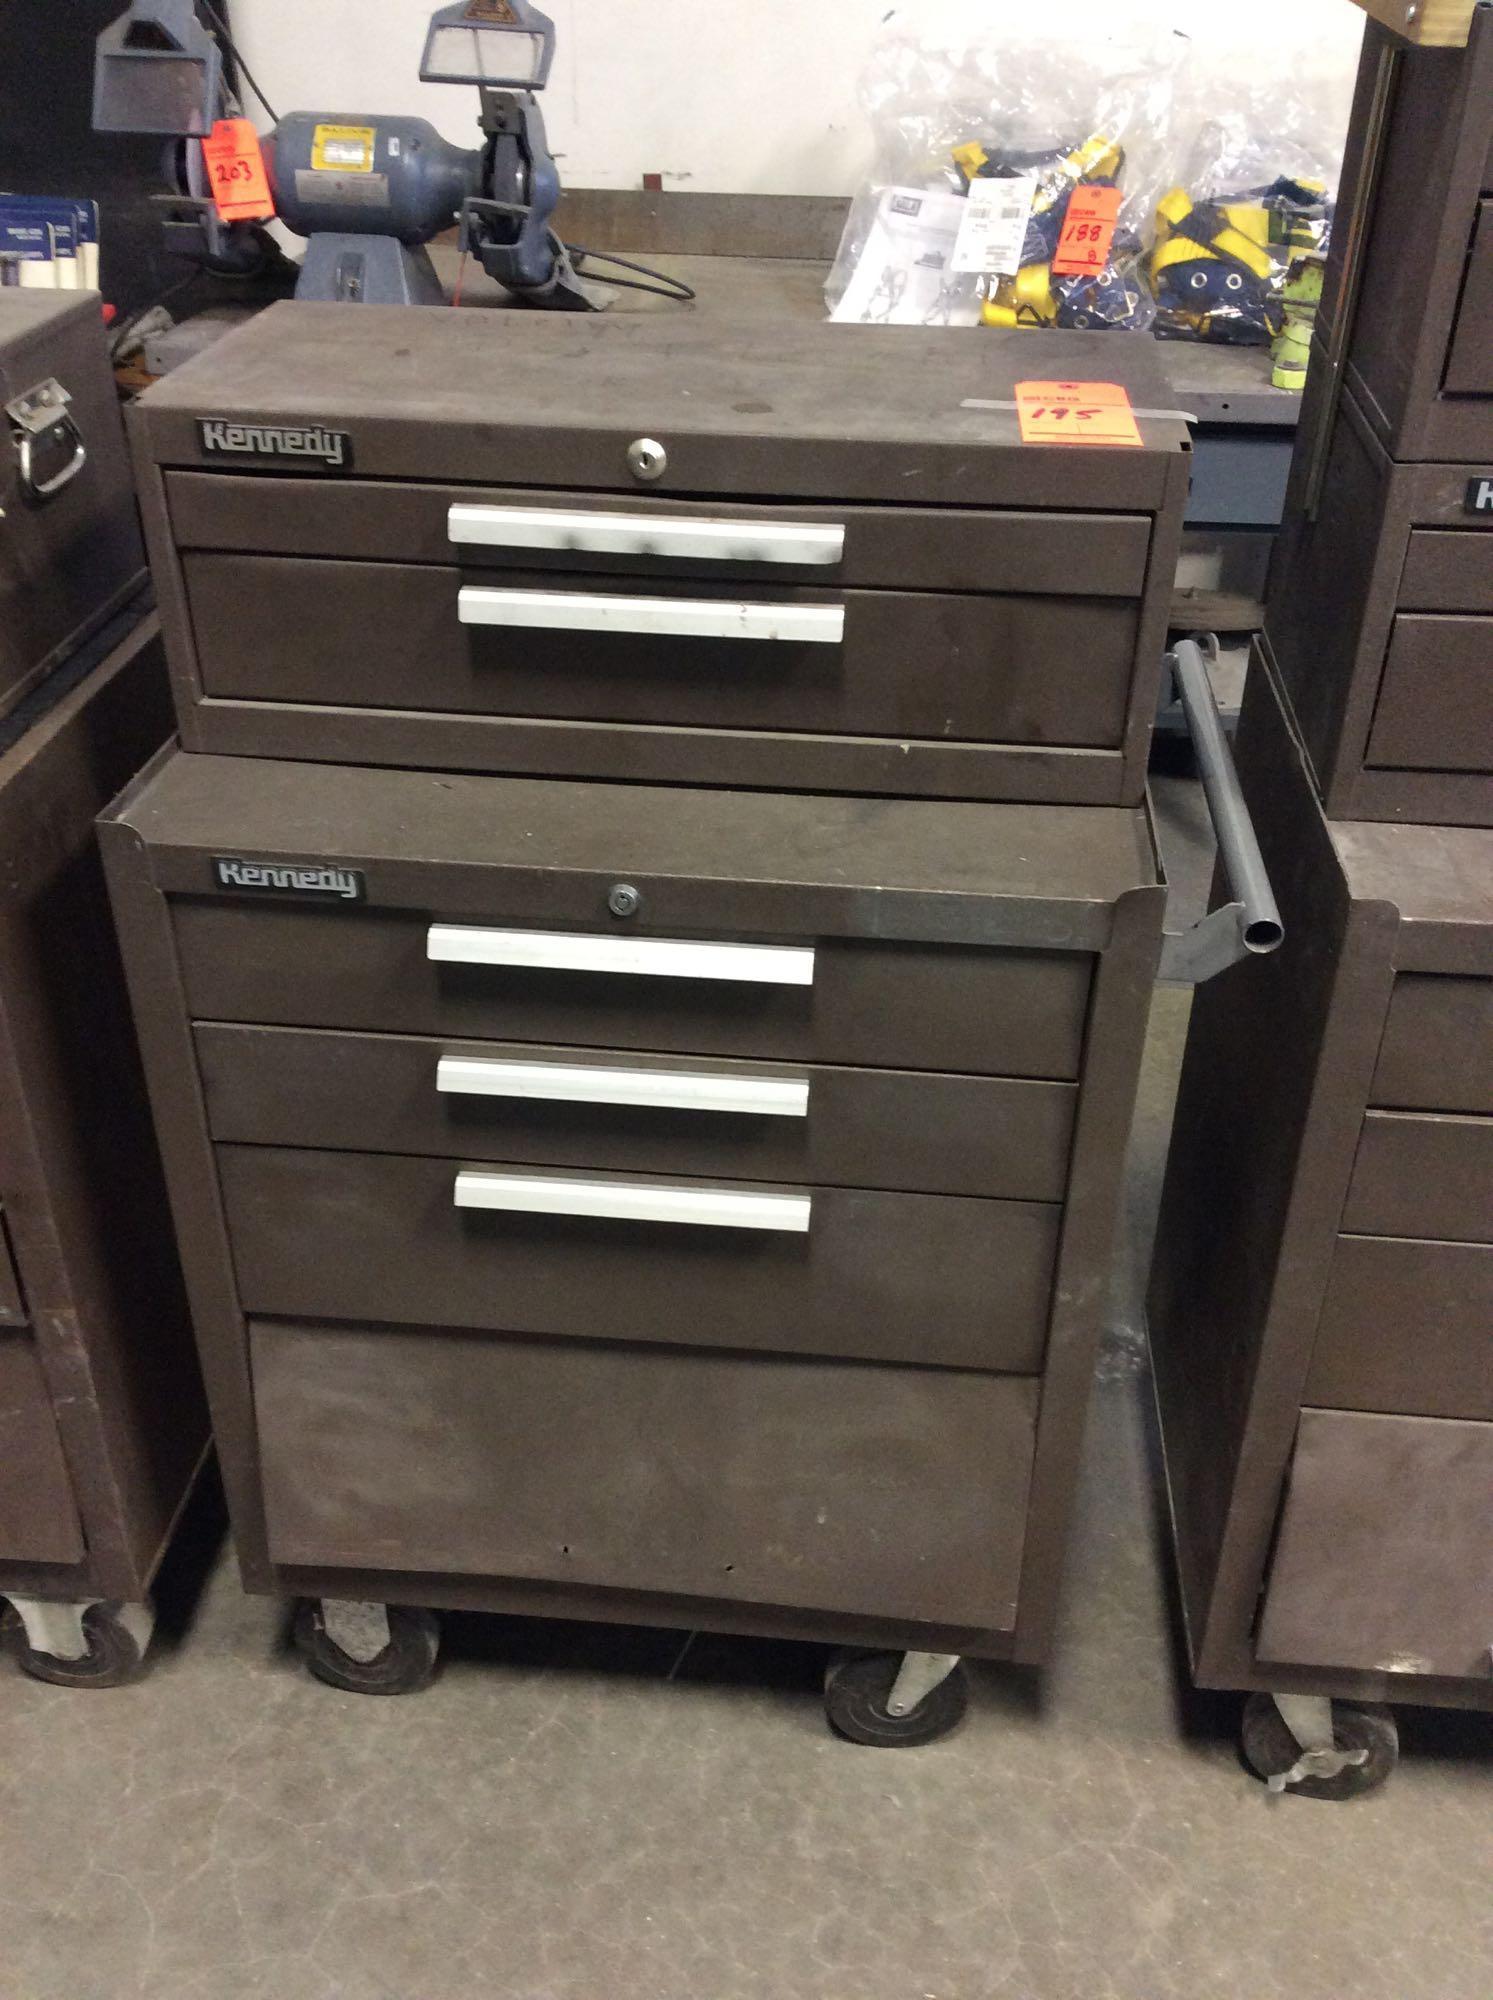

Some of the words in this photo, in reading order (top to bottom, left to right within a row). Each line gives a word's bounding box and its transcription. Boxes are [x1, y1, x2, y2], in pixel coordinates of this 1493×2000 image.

[215, 160, 253, 183] 203
[1065, 223, 1103, 242] 188
[1031, 407, 1104, 420] 195
[202, 421, 344, 465] Kennedy
[218, 862, 358, 899] Kennedy
